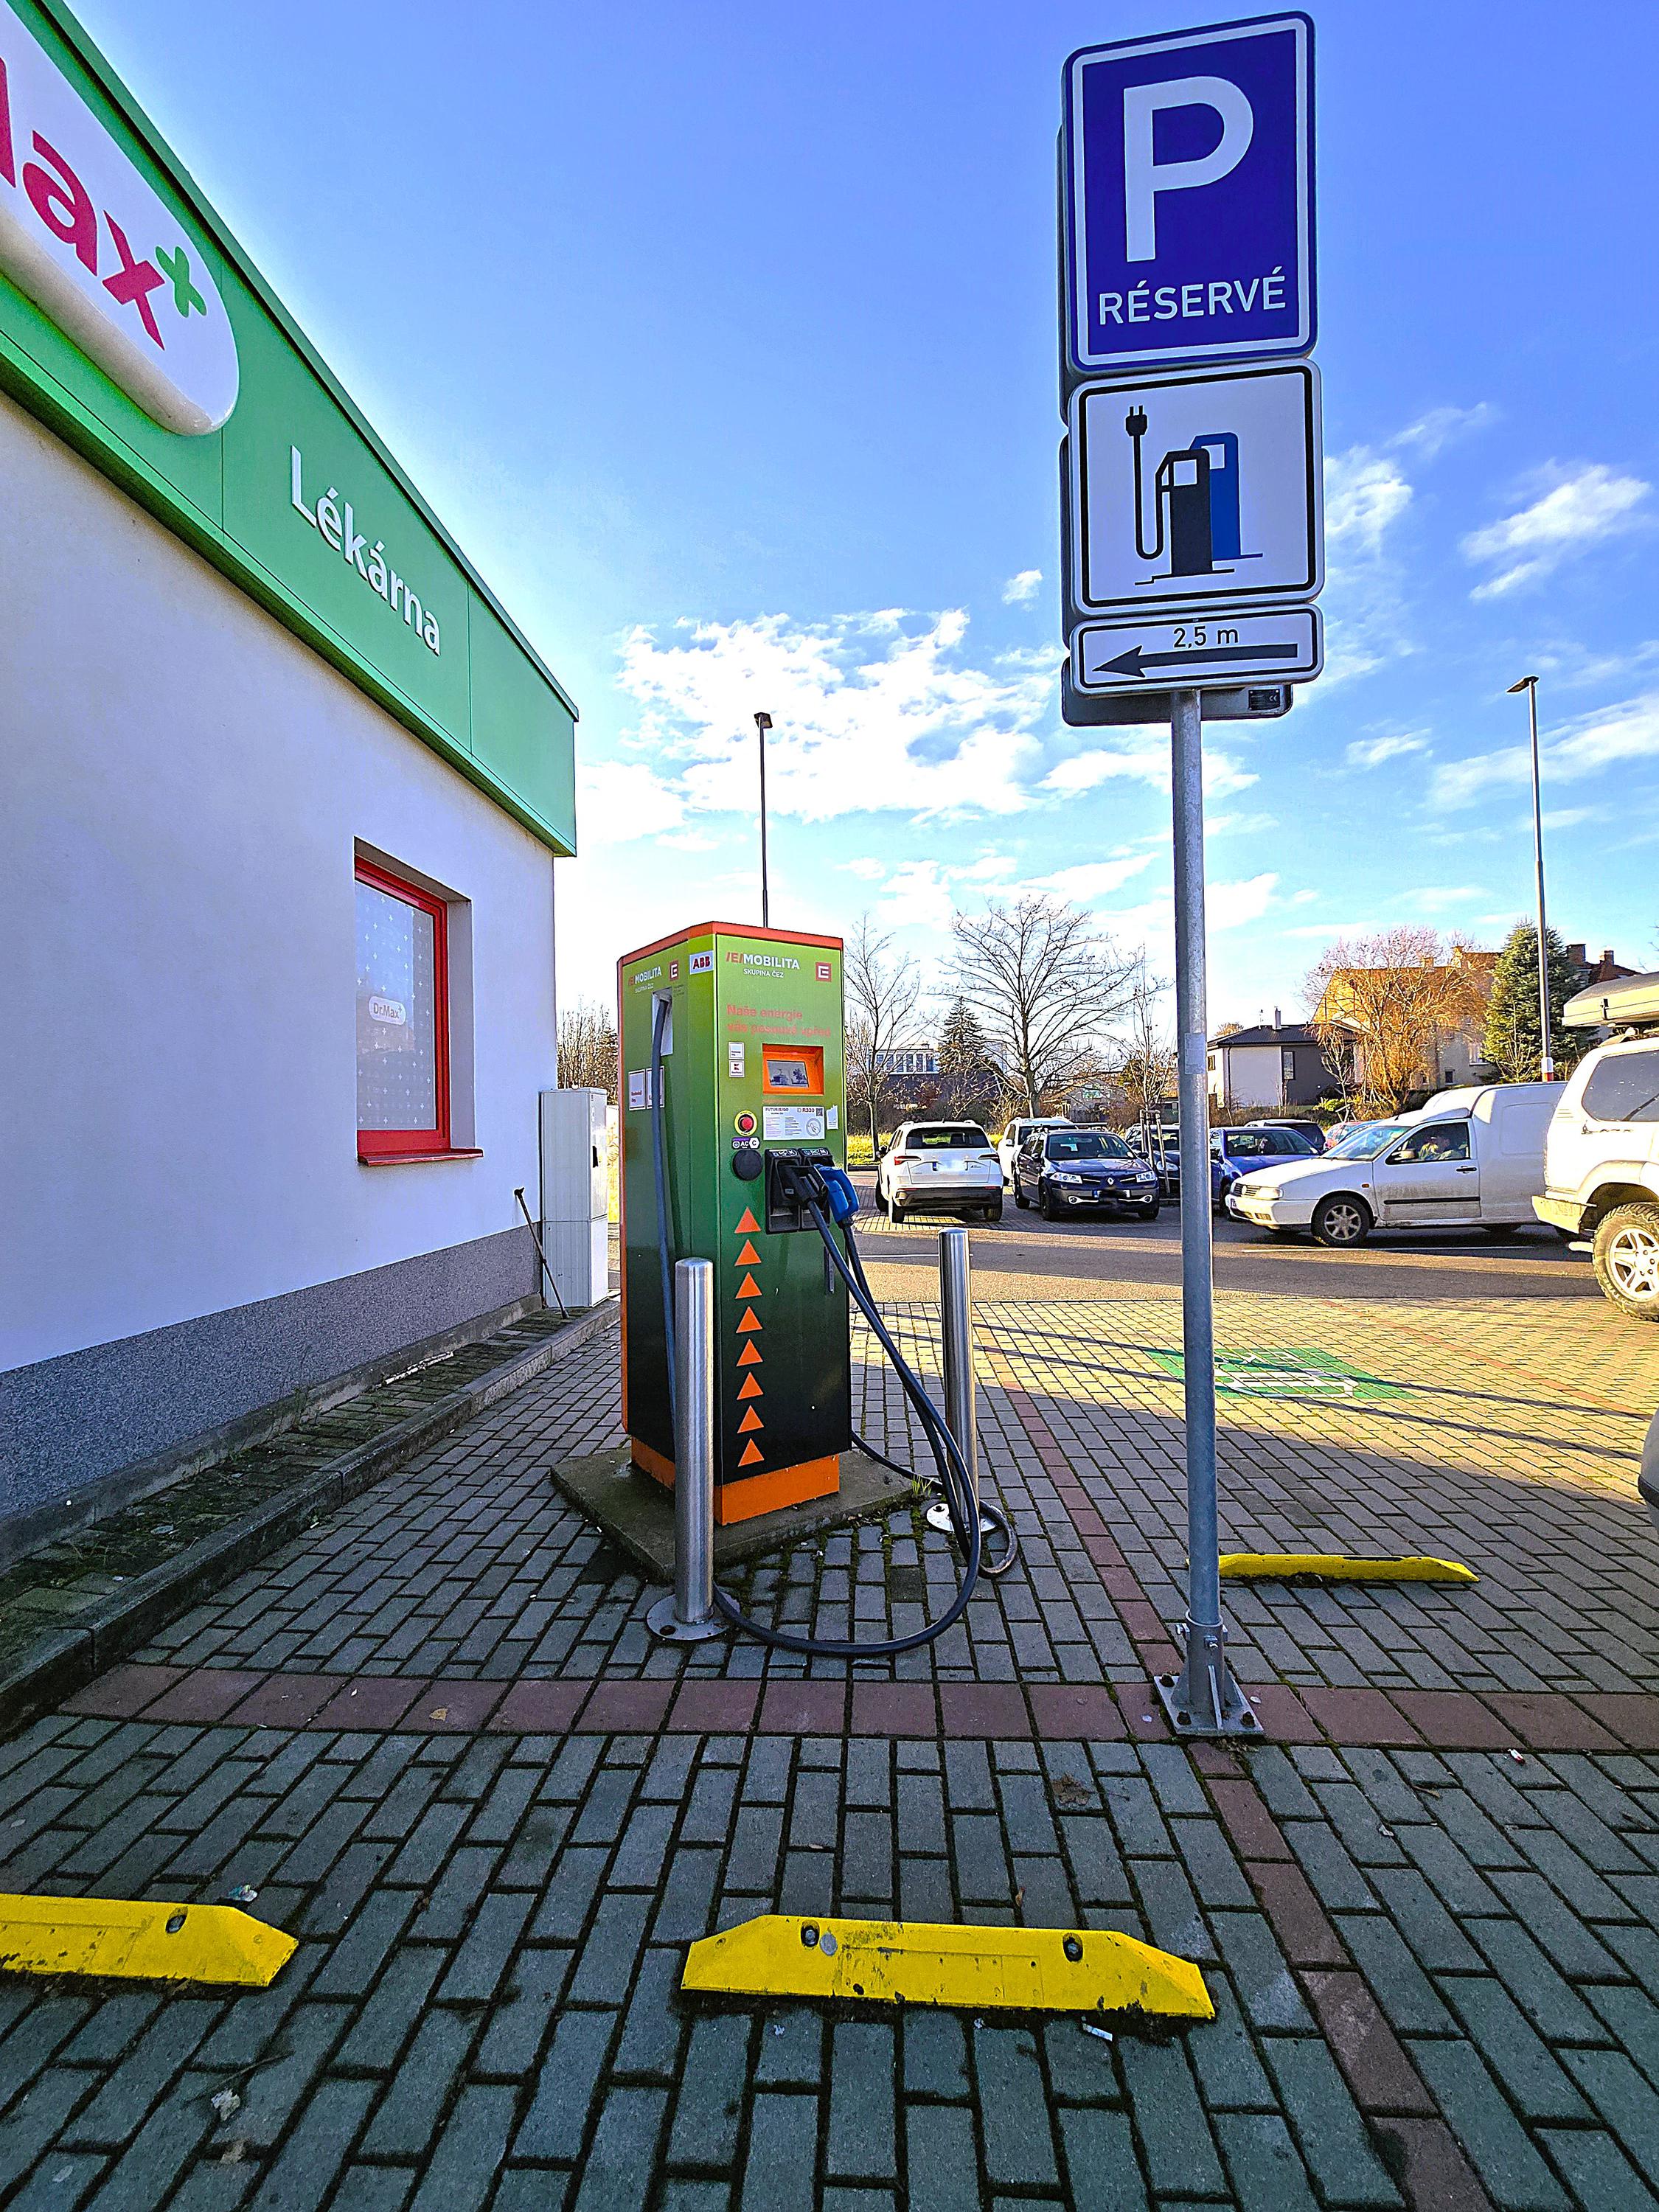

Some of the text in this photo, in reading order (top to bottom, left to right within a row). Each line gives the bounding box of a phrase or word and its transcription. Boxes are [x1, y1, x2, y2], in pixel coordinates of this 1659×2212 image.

[1123, 76, 1253, 262] P
[1099, 266, 1287, 325] RÉSERVÉ
[291, 445, 441, 656] Lékárna
[1173, 625, 1239, 650] 2,5 m
[692, 956, 711, 970] ABB
[743, 968, 785, 978] SKUPINA ČEZ
